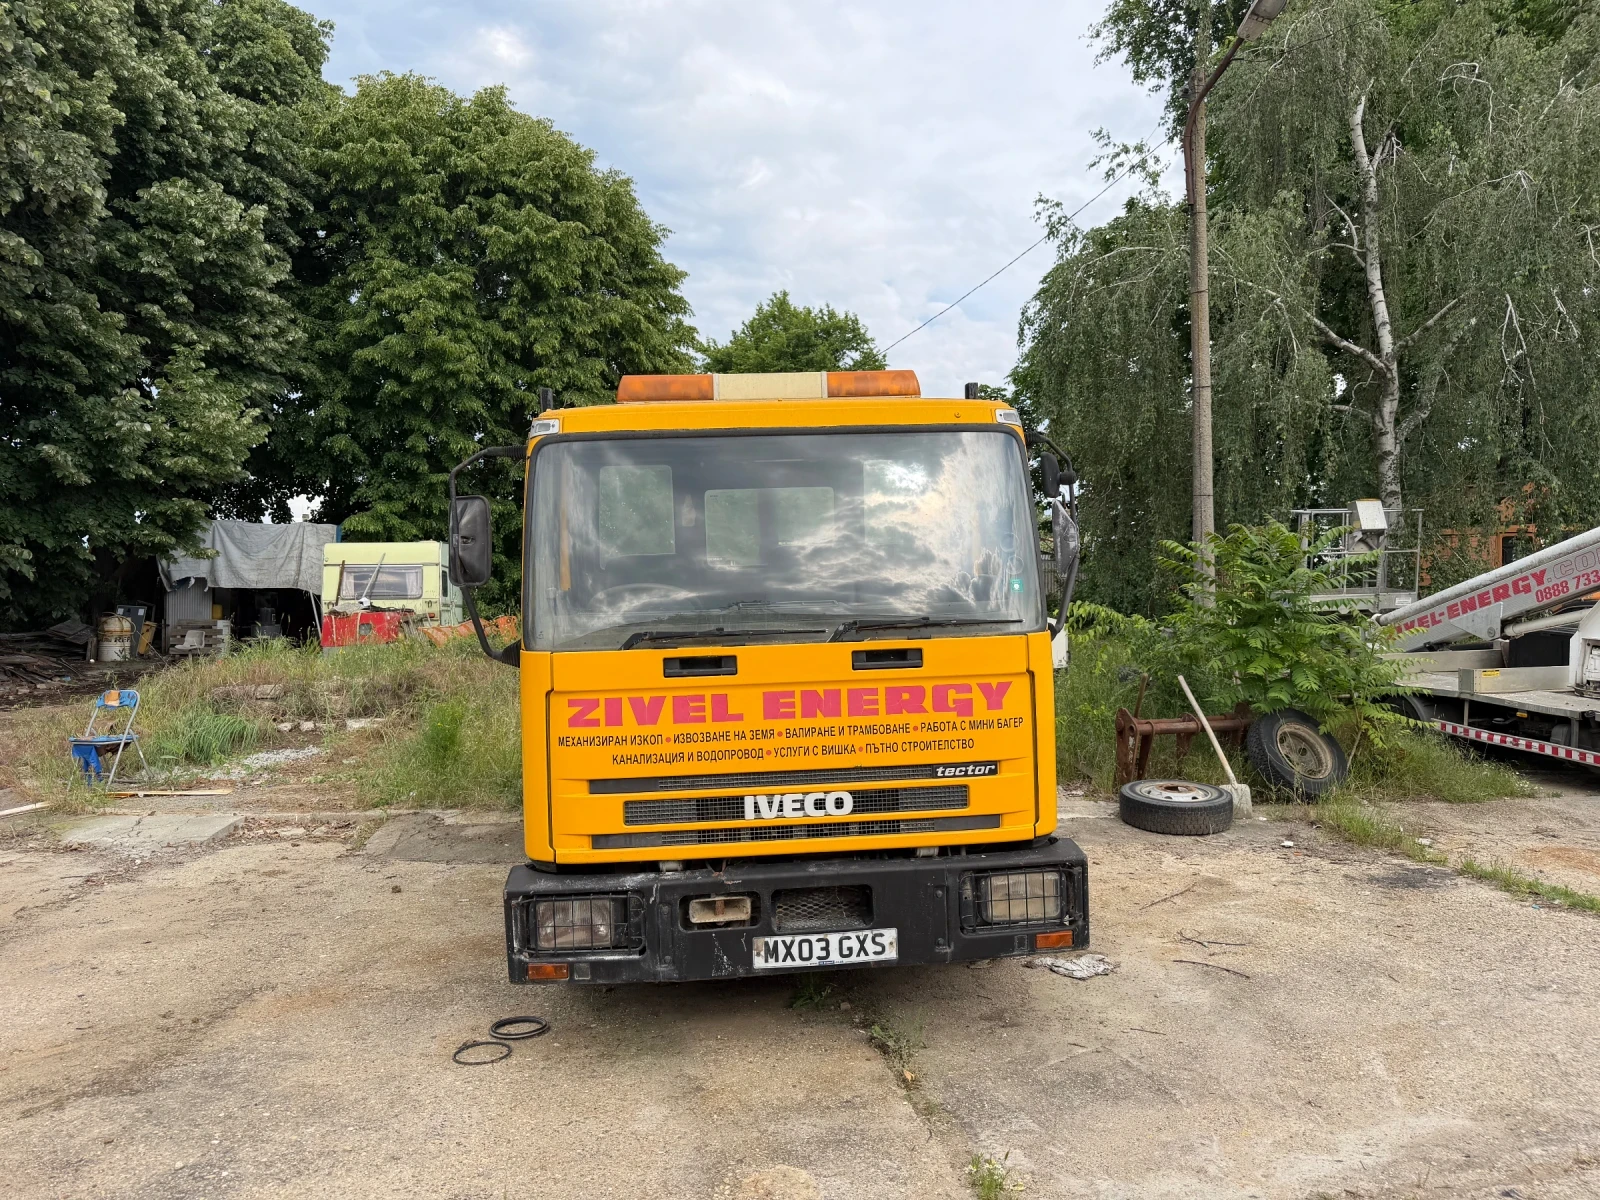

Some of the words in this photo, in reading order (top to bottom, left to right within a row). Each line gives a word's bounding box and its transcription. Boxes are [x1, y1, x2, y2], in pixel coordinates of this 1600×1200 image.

[1535, 580, 1570, 603] 0888
[567, 693, 744, 728] ZIVEL
[762, 681, 1013, 721] ENERGY
[557, 734, 629, 748] МЕХАНИЗИРАН
[630, 734, 664, 747] ИЗКОП
[673, 730, 731, 745] ИЗВОЗВАНЕ
[733, 729, 747, 742] НА
[749, 728, 775, 741] ЗЕМЯ
[785, 725, 836, 739] ВАЛИРАНЕ
[838, 725, 845, 737] И
[847, 722, 911, 737] ТРАМБОВАНЕ
[920, 720, 958, 733] РАБОТА
[960, 719, 966, 731] С
[968, 718, 995, 731] МИНИ
[997, 716, 1024, 730] БАГЕР
[612, 751, 685, 766] КАНАЛИЗАЦИЯ
[687, 751, 694, 763] И
[696, 747, 764, 763] ВОДОПРОВОД
[773, 745, 810, 758] УСЛУГИ
[812, 745, 819, 757] С
[821, 743, 857, 756] ВИШКА
[865, 741, 899, 755] ПЪТНО
[901, 738, 975, 753] СТРОИТЕЛСТВО
[936, 763, 996, 778] tector
[744, 791, 854, 820] IVECO
[763, 936, 831, 964] MX03
[838, 932, 886, 959] GXS
